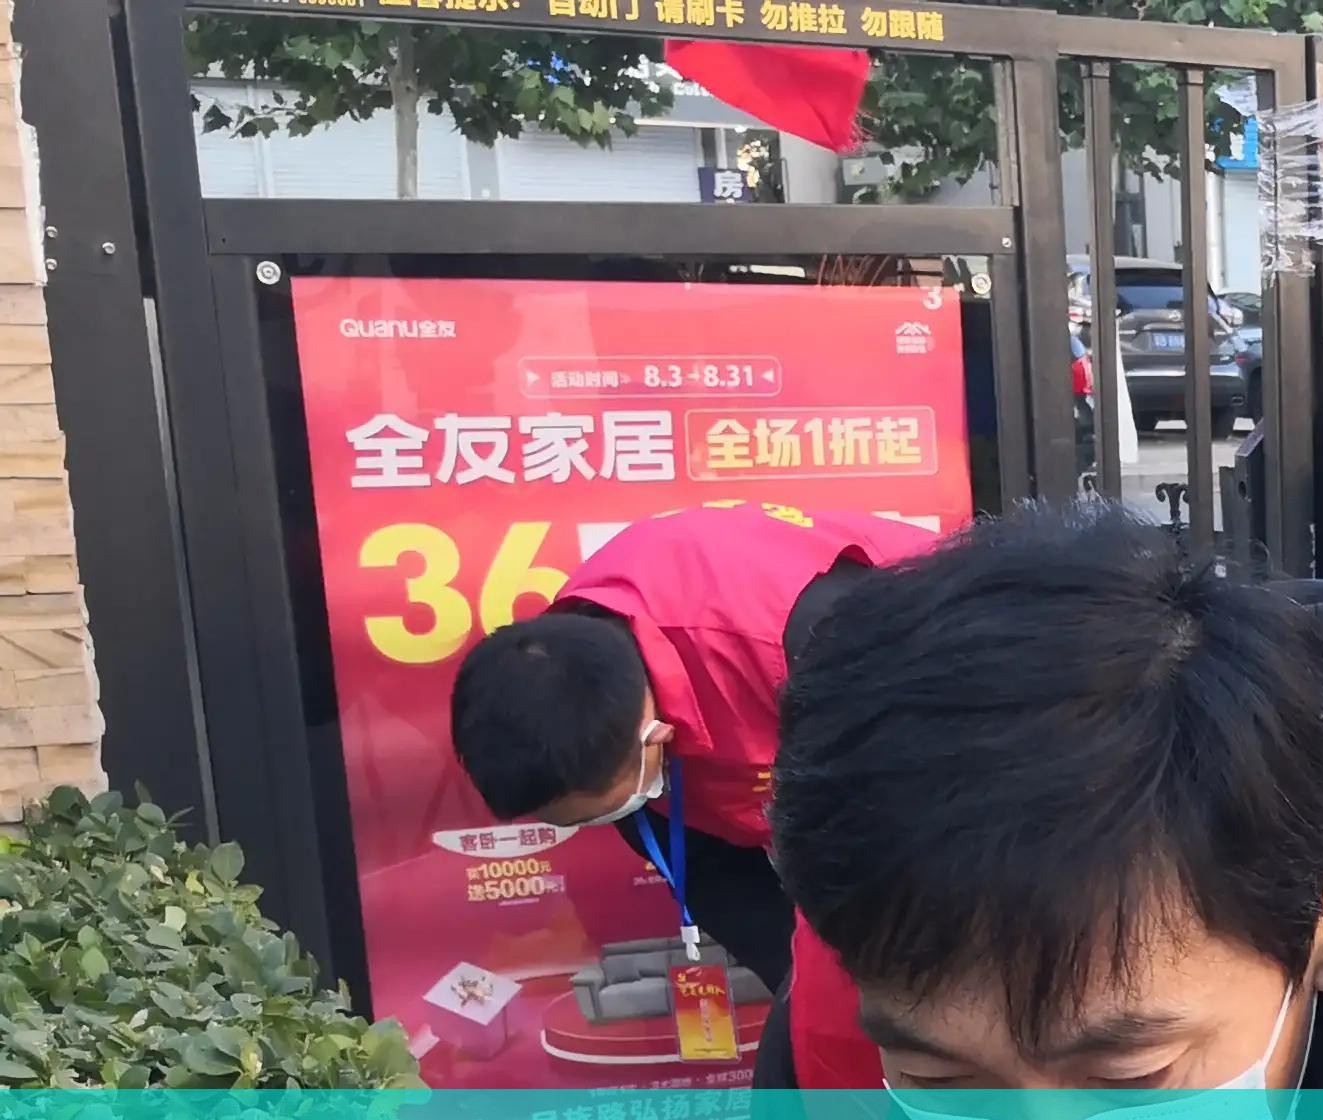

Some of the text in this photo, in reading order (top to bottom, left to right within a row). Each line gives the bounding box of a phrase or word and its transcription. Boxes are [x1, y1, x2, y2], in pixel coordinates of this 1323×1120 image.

[656, 0, 745, 28] 请刷卡
[760, 0, 848, 35] 勿推拉
[860, 7, 945, 42] 勿跟随
[713, 171, 744, 199] 房
[345, 409, 923, 489] 全友家居 全场1折起
